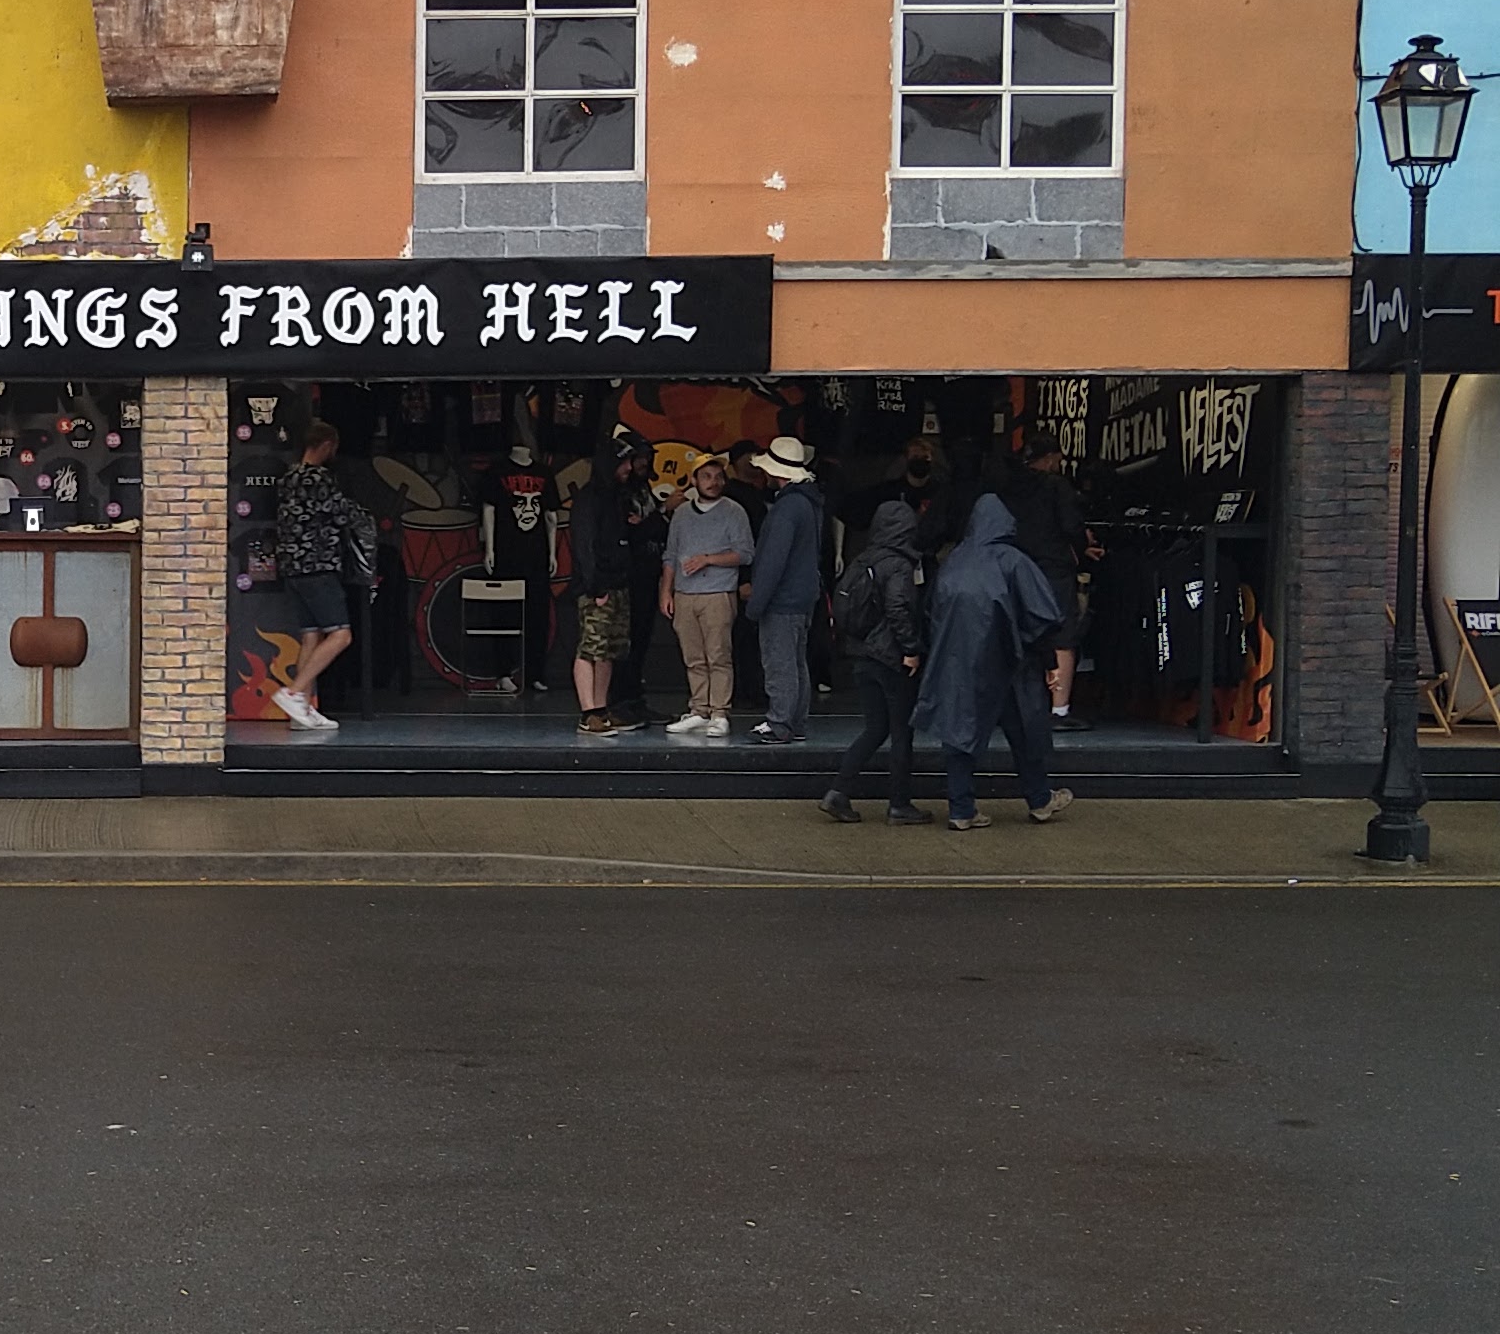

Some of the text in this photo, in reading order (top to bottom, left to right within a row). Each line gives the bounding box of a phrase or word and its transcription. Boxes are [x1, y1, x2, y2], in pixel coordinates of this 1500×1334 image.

[219, 284, 444, 347] FROM
[480, 281, 697, 347] HELL
[1037, 378, 1090, 419] TINGS
[1179, 377, 1261, 478] HELLFEST
